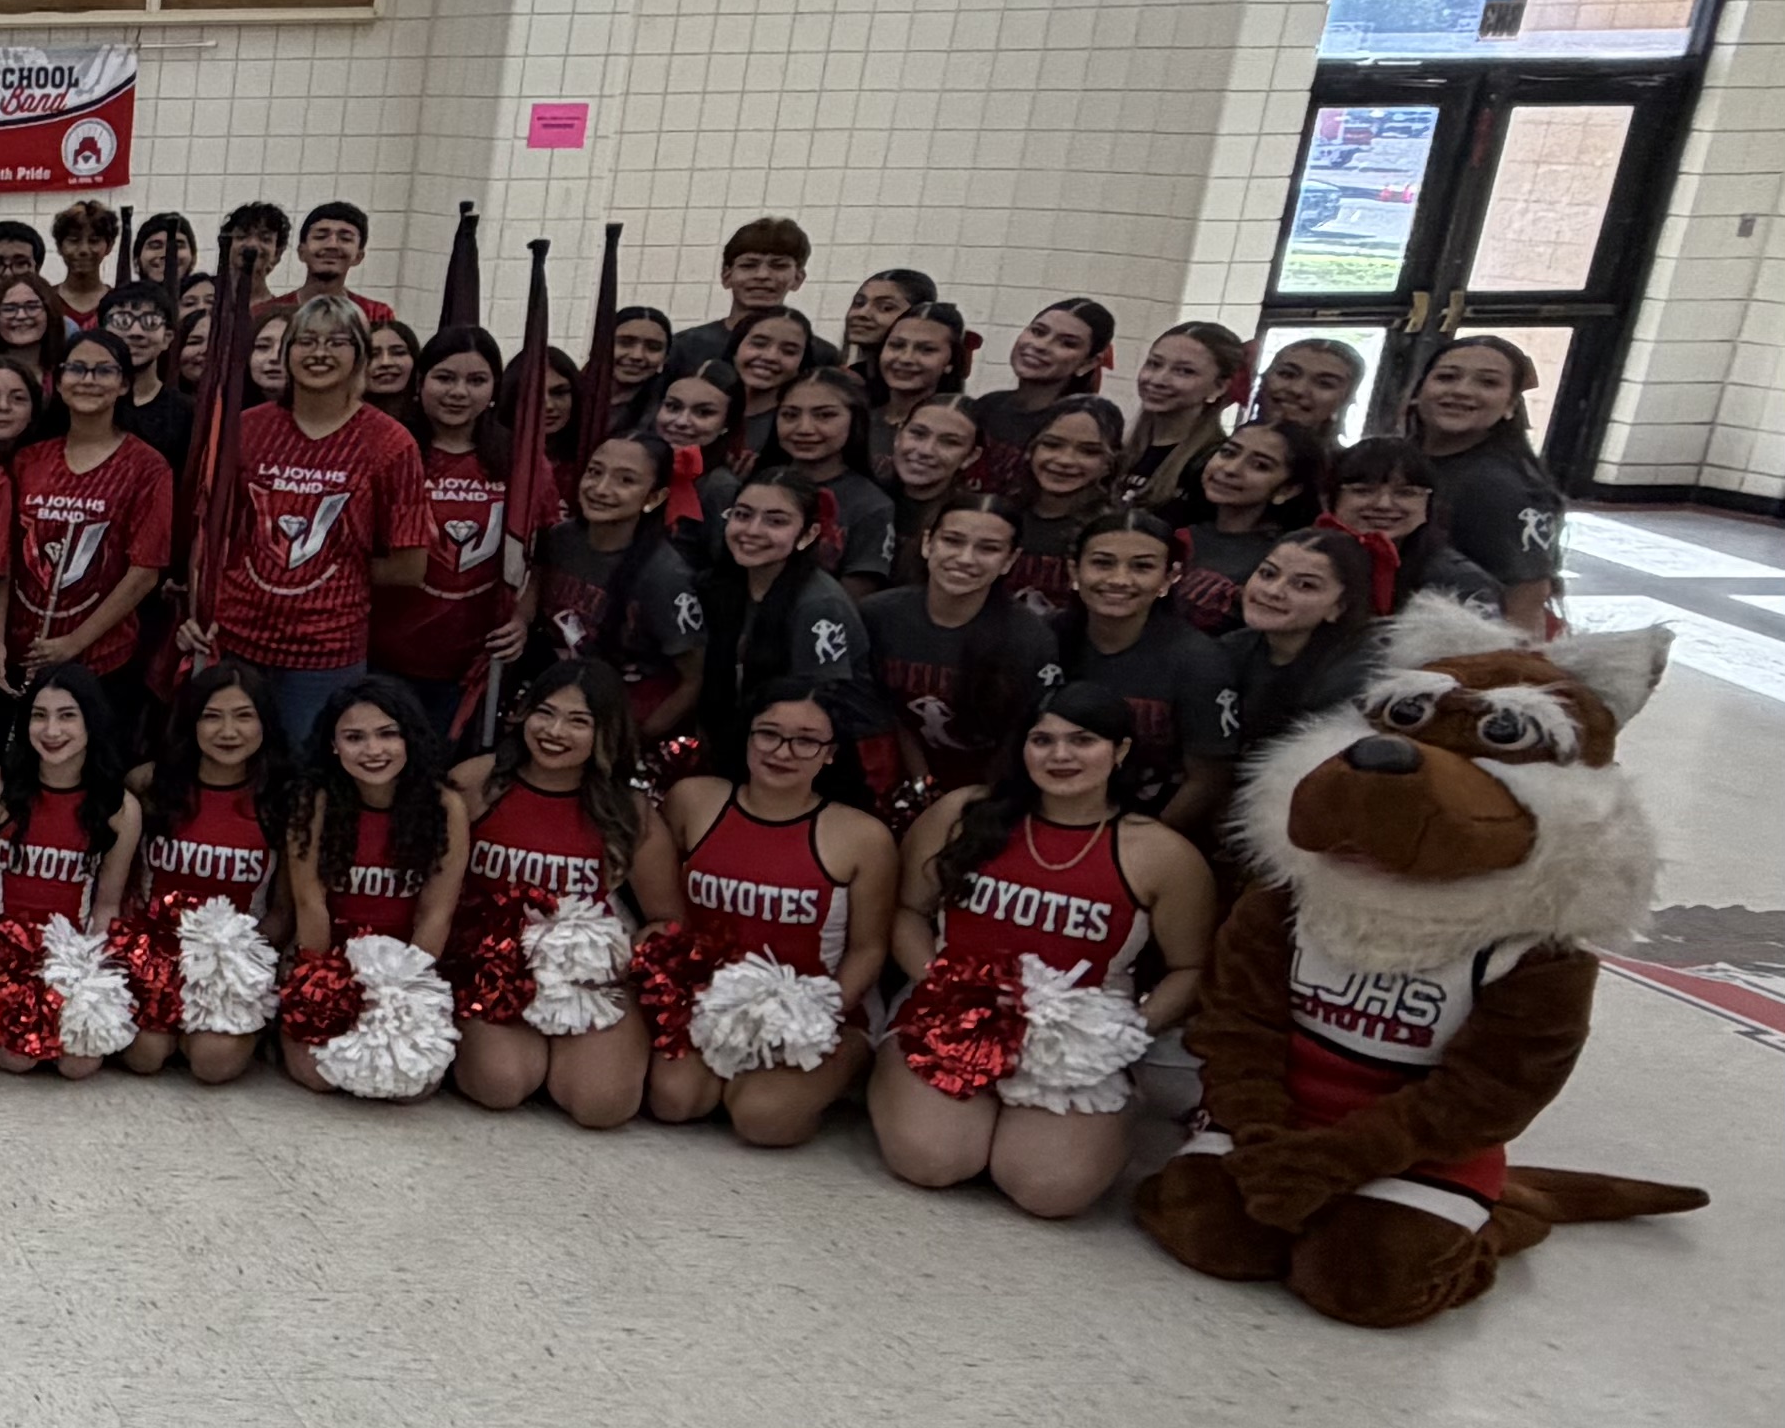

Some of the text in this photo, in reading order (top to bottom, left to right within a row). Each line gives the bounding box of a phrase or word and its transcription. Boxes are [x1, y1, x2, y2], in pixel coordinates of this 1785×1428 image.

[0, 85, 68, 115] Band
[17, 166, 51, 180] Pride
[258, 463, 348, 483] LA JOYA HS
[272, 477, 323, 494] BAND
[438, 478, 483, 490] JOYA
[484, 480, 506, 492] HS
[25, 494, 106, 512] LA JOYA HS
[431, 490, 488, 502] BAND
[37, 508, 85, 523] BAND
[149, 835, 264, 883] COYOTES
[470, 839, 599, 893] COYOTES
[688, 869, 819, 924] COYOTES
